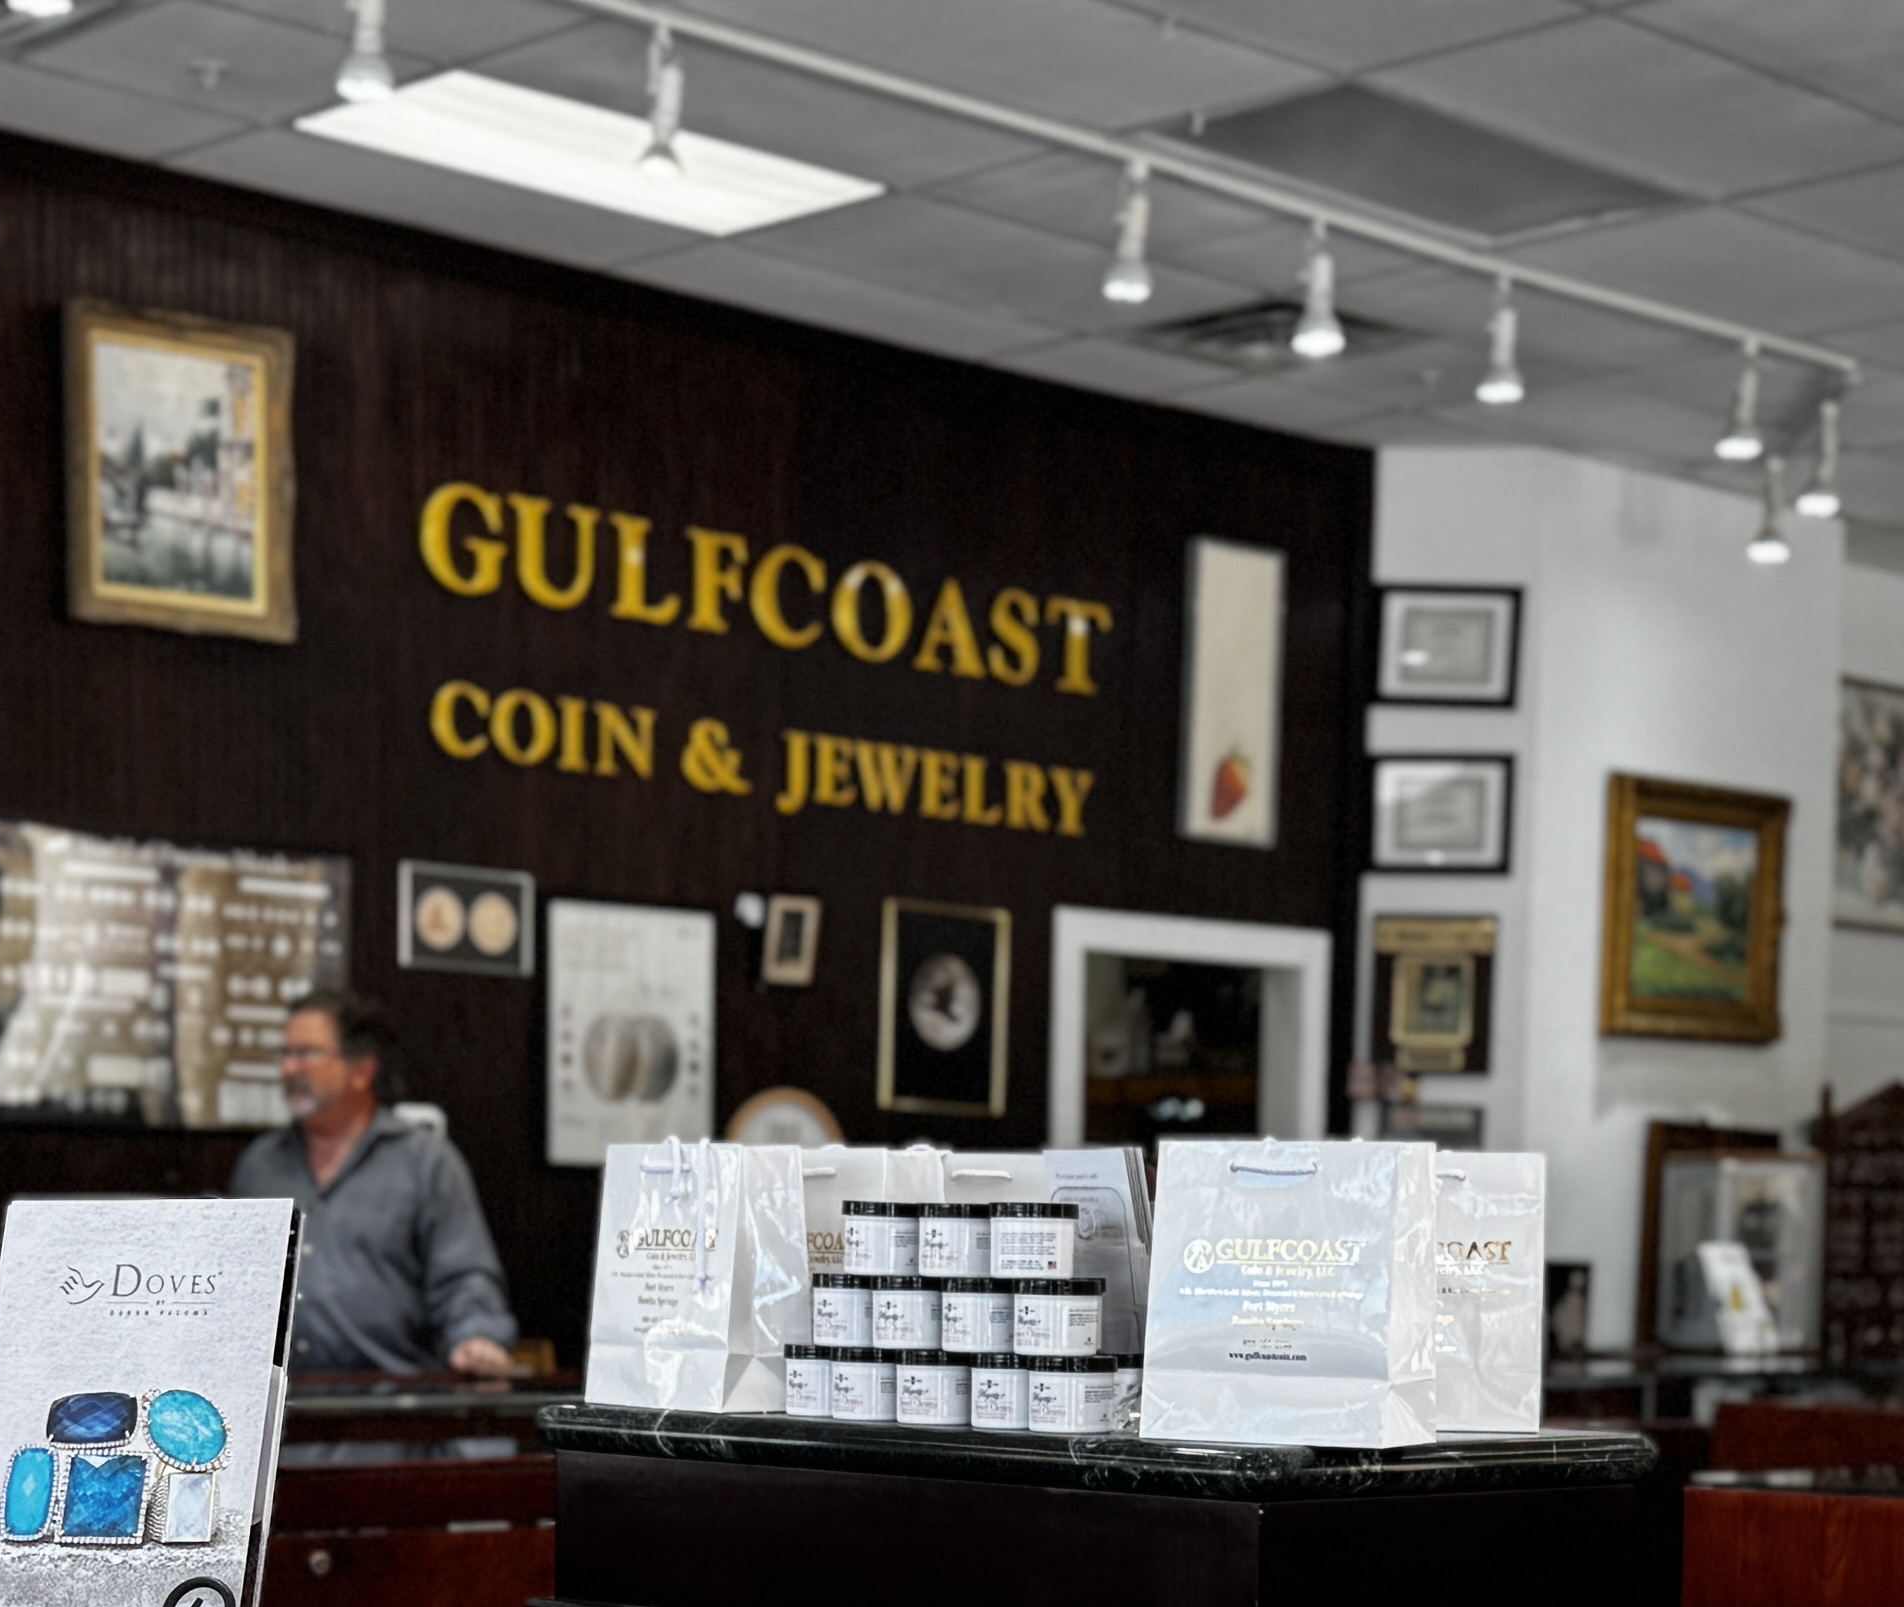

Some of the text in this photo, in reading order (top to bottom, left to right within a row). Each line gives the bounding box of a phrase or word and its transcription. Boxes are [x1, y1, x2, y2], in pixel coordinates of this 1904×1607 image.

[418, 482, 1113, 695] GULFCOAST
[430, 680, 1094, 837] COIN & JEWELRY
[1215, 1237, 1367, 1263] GULFCOAST
[112, 1263, 216, 1298] DOVES
[1242, 1301, 1264, 1312] Fort
